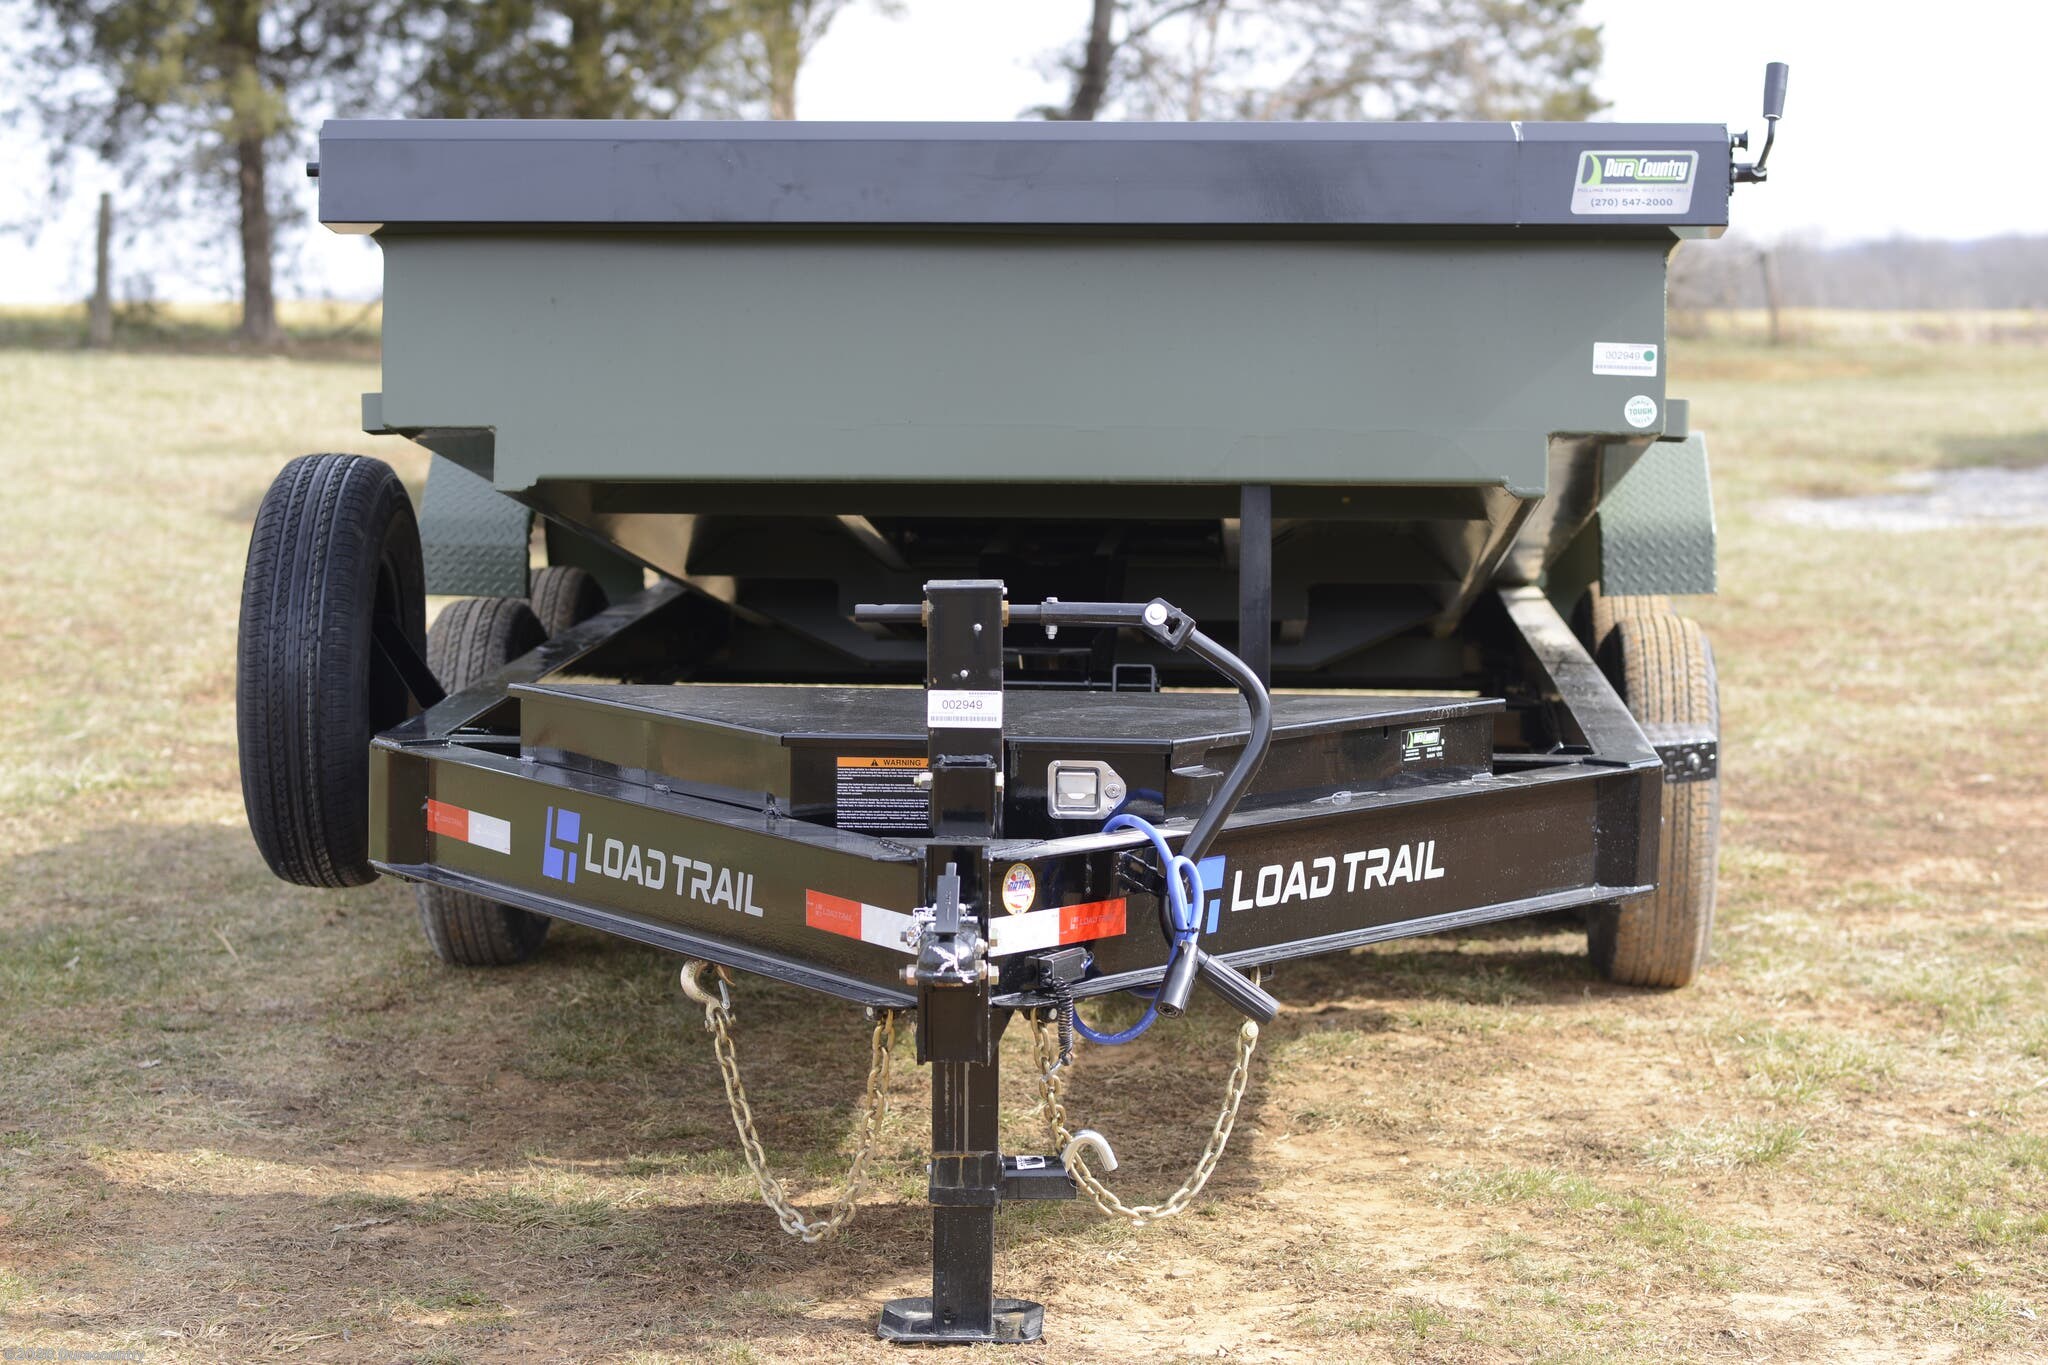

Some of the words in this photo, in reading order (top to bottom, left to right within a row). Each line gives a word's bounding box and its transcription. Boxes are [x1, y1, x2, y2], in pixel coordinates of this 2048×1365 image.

[1603, 158, 1635, 177] Dura
[1637, 158, 1689, 181] Country
[1590, 198, 1618, 207] (270)
[1622, 198, 1673, 207] 547-2000
[1605, 351, 1641, 360] 002949
[941, 699, 983, 710] 002949
[584, 832, 667, 890] LOAD
[672, 854, 764, 918] TRAIL
[1231, 855, 1336, 912] LOAD
[1343, 840, 1445, 893] TRAIL
